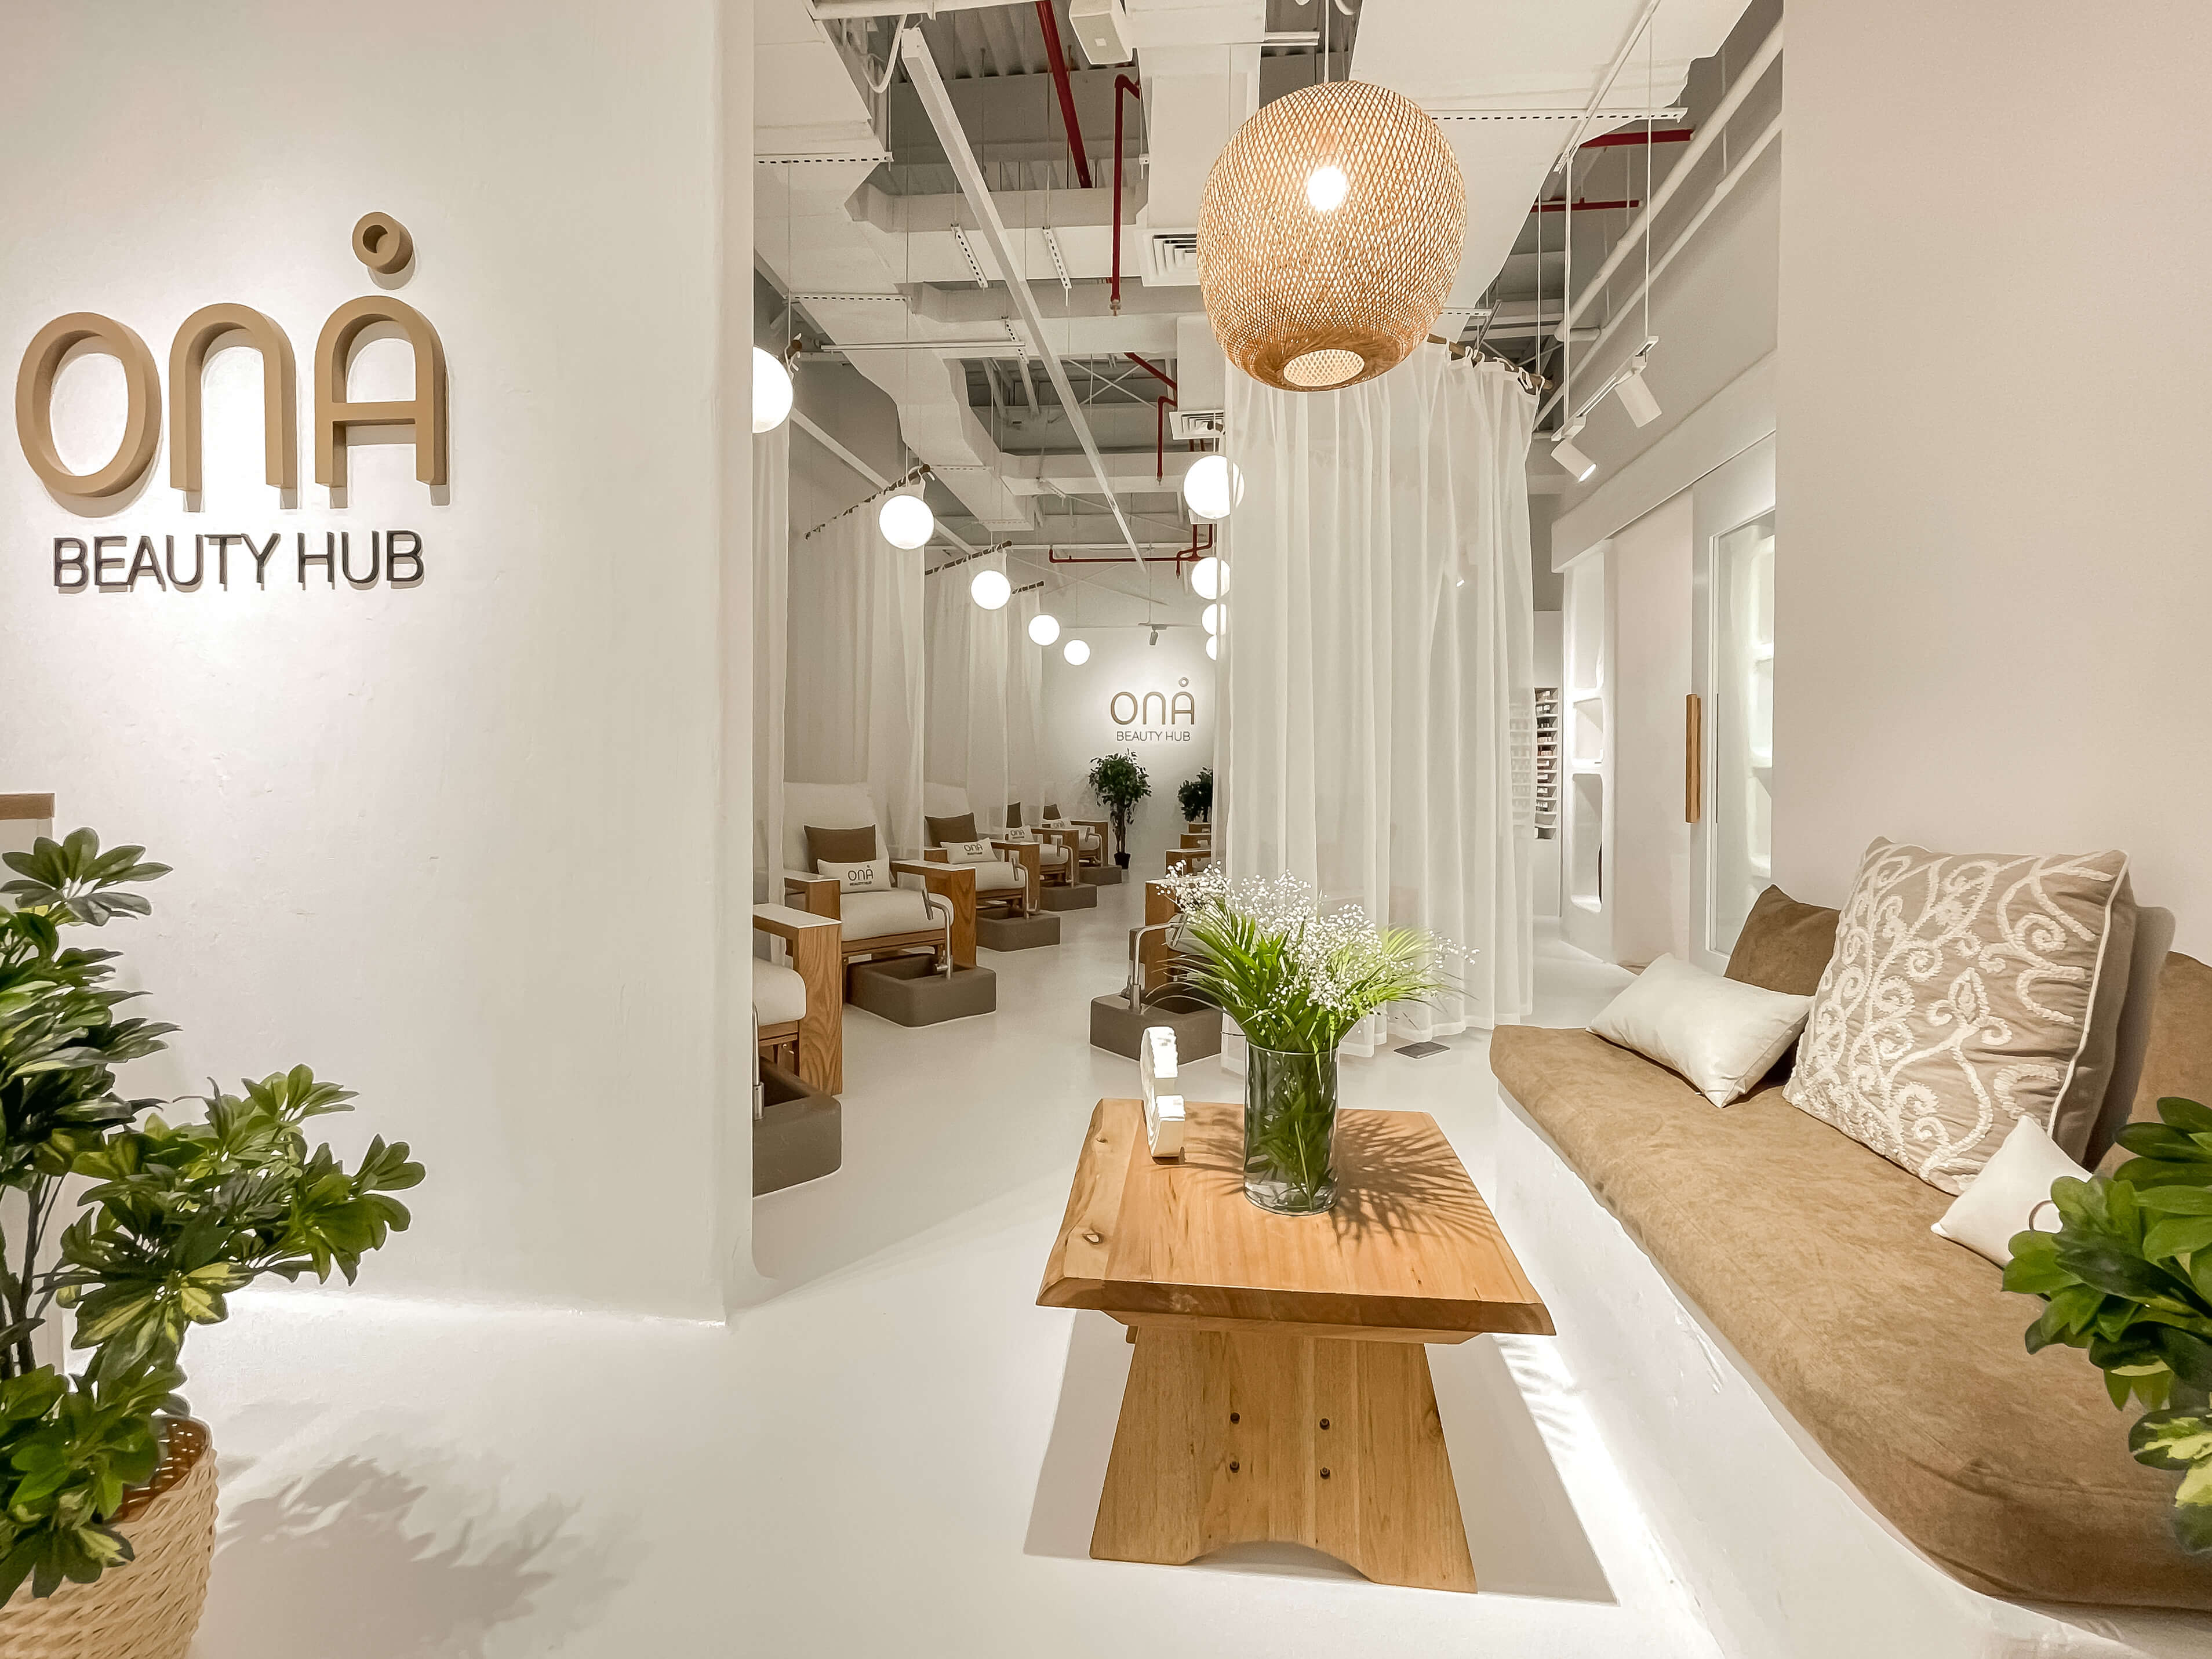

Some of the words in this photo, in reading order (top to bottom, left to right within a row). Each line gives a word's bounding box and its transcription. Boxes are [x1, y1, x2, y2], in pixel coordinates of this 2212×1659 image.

[53, 532, 282, 590] BEAUTY
[297, 530, 425, 588] HUB
[1116, 731, 1163, 741] BEAUTY
[1165, 731, 1191, 741] HUB
